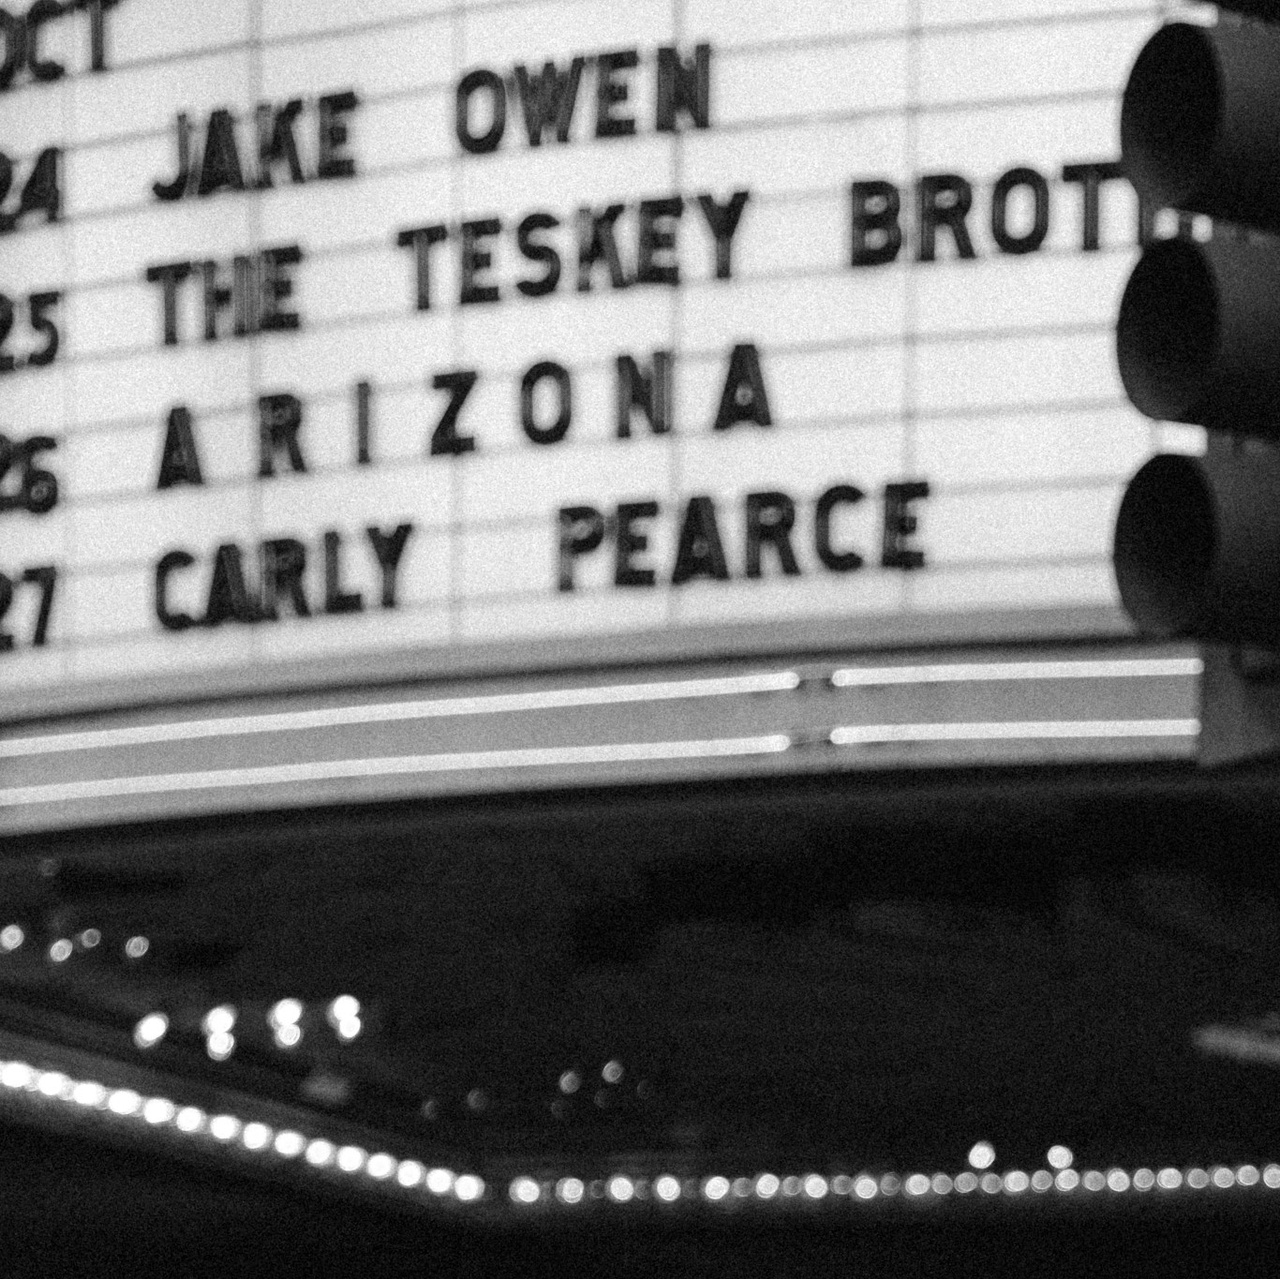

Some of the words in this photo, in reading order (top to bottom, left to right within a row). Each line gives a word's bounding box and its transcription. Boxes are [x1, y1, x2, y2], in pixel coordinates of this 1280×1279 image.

[153, 92, 357, 200] JAKE
[455, 44, 711, 154] OWEN
[147, 246, 300, 345] THE
[398, 192, 749, 311] TESKEY
[154, 524, 412, 631] CARLY
[558, 482, 930, 592] PEARCE
